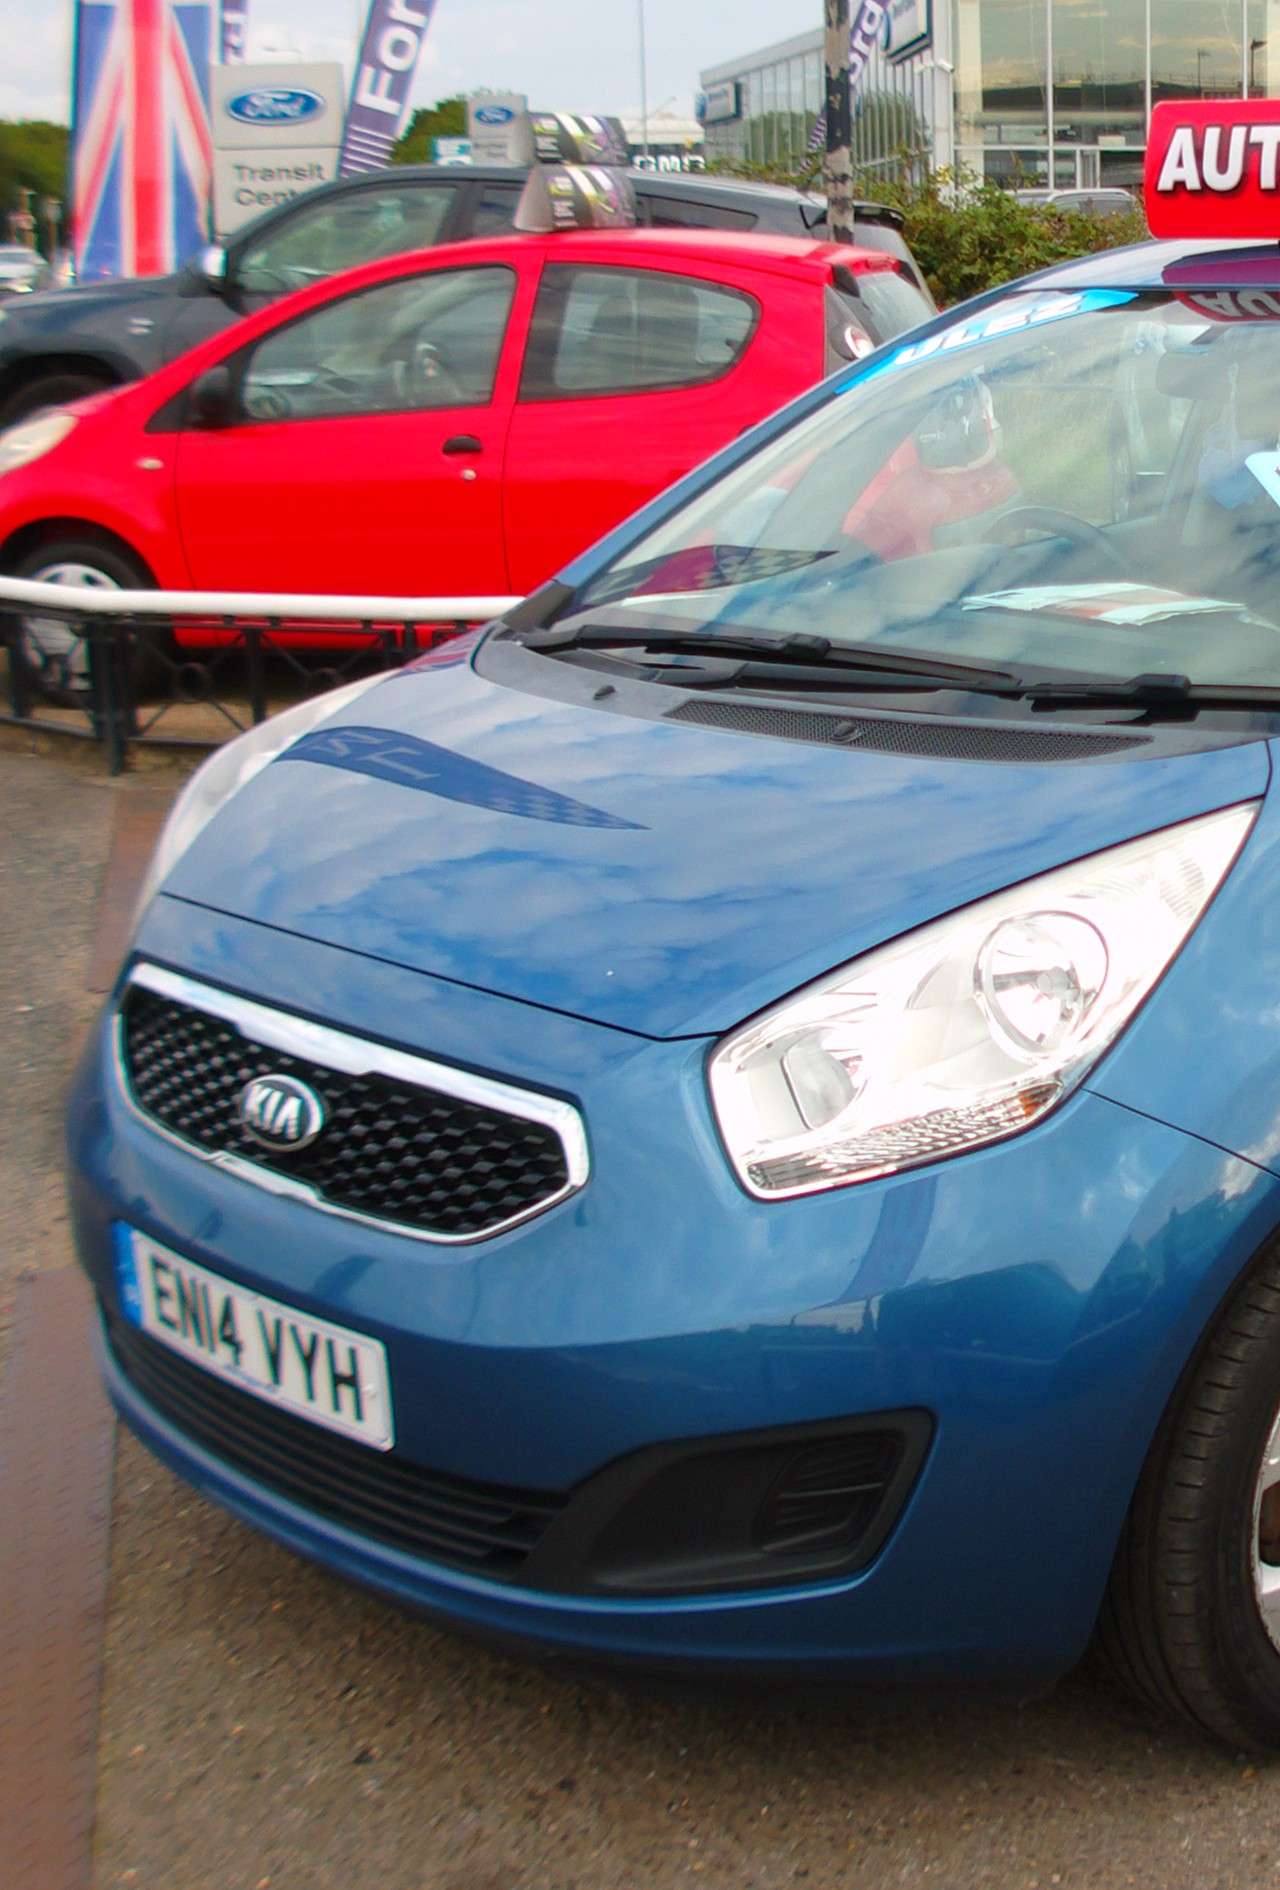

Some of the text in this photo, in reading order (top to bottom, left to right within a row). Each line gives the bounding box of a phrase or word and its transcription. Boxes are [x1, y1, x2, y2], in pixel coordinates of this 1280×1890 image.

[848, 0, 884, 84] ord
[232, 161, 326, 182] Transit
[894, 293, 1088, 366] ULEZ
[243, 1082, 302, 1141] KIA
[149, 1255, 364, 1423] EN14 VYH
